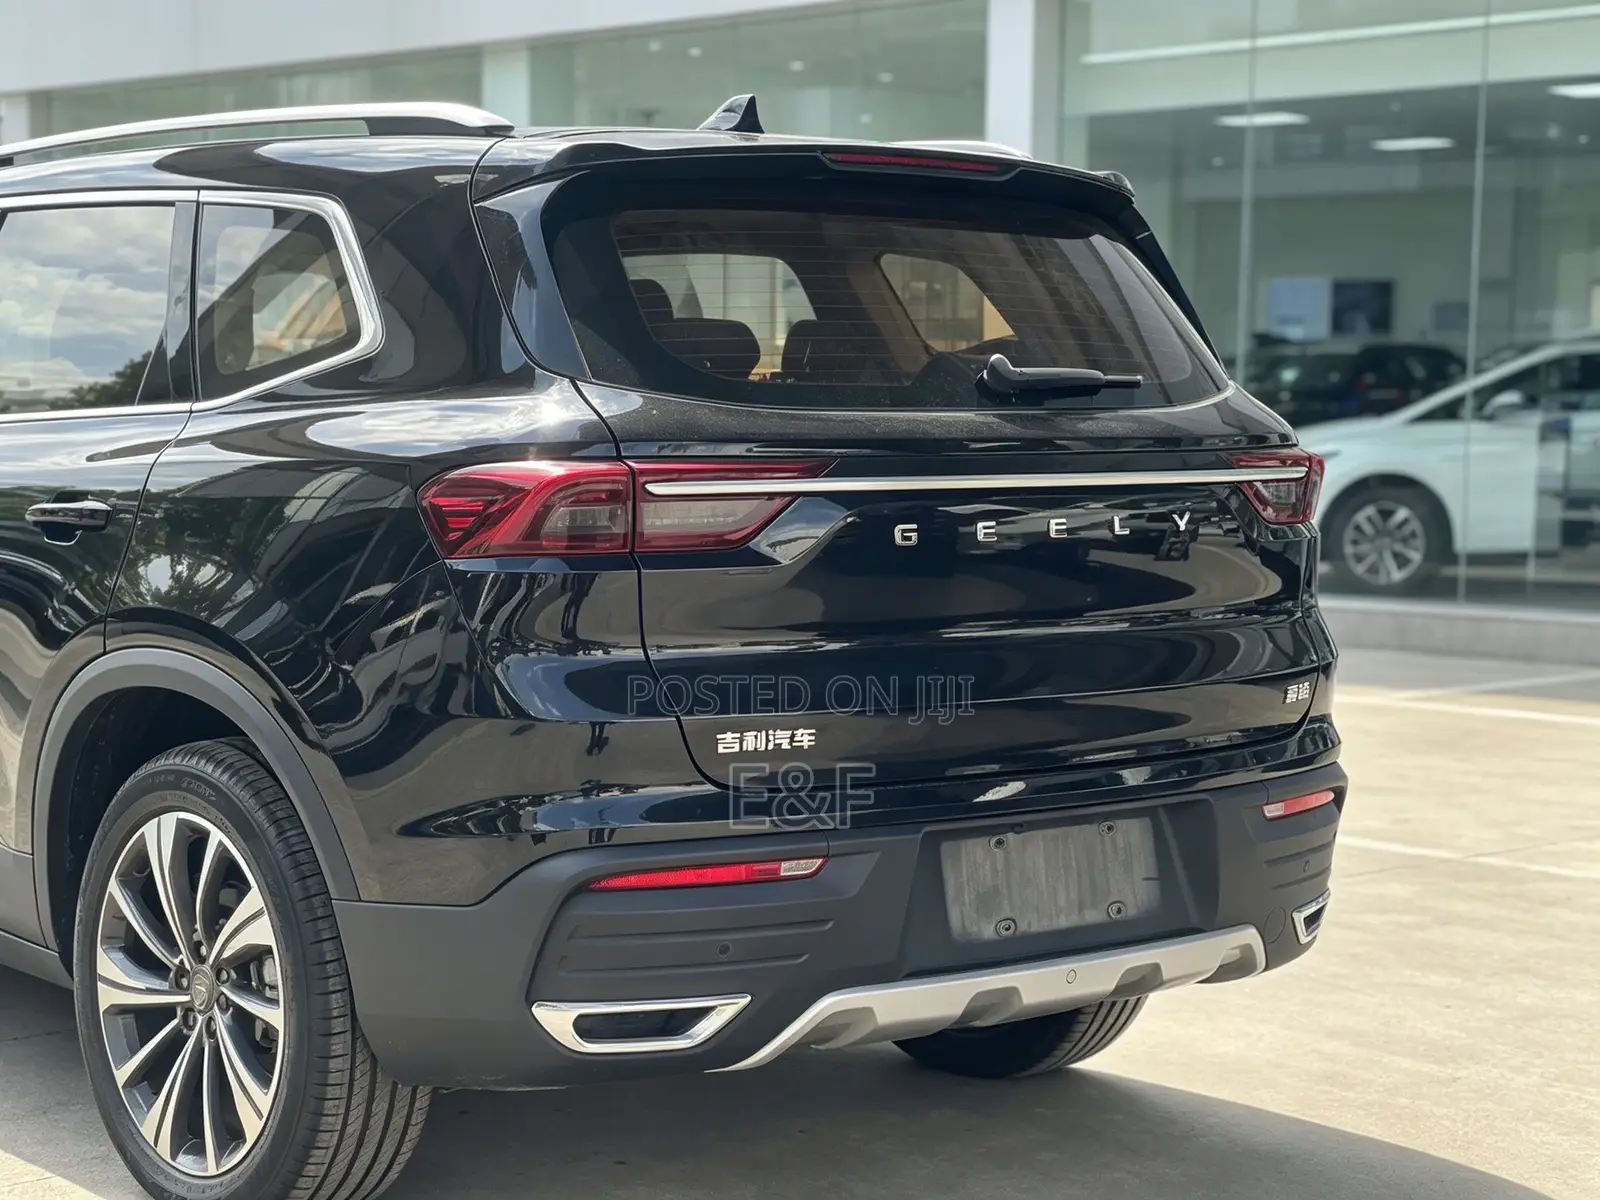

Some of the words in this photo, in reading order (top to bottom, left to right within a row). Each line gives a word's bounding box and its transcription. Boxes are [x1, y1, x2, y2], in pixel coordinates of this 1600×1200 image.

[894, 511, 1191, 546] GEELY
[716, 728, 817, 754] 吉利汽车
